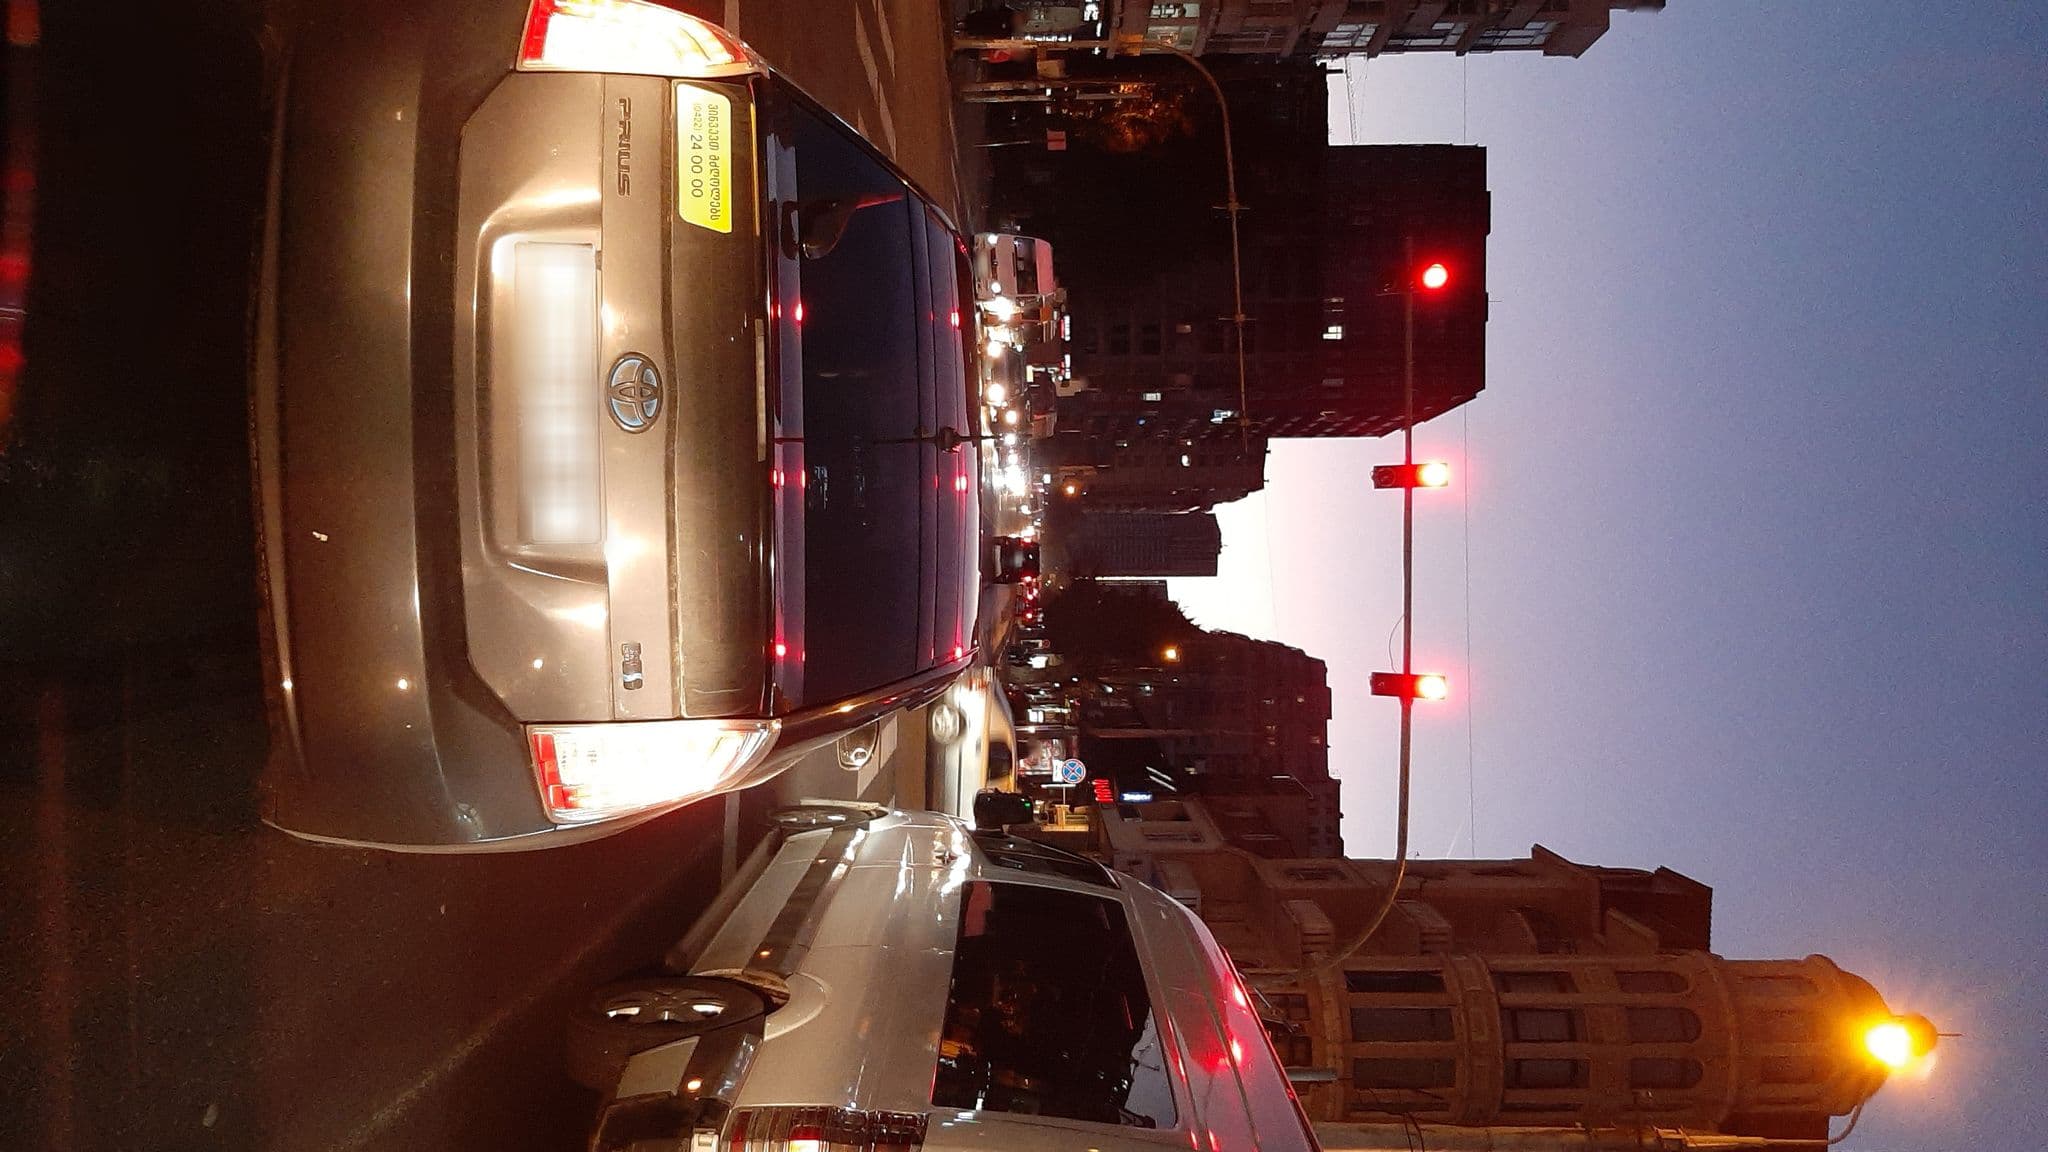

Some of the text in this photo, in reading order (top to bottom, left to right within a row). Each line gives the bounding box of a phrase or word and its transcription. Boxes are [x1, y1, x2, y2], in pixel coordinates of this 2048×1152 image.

[617, 97, 632, 197] PRIUS
[690, 134, 703, 150] 24
[690, 155, 704, 175] 00
[691, 178, 704, 198] 00
